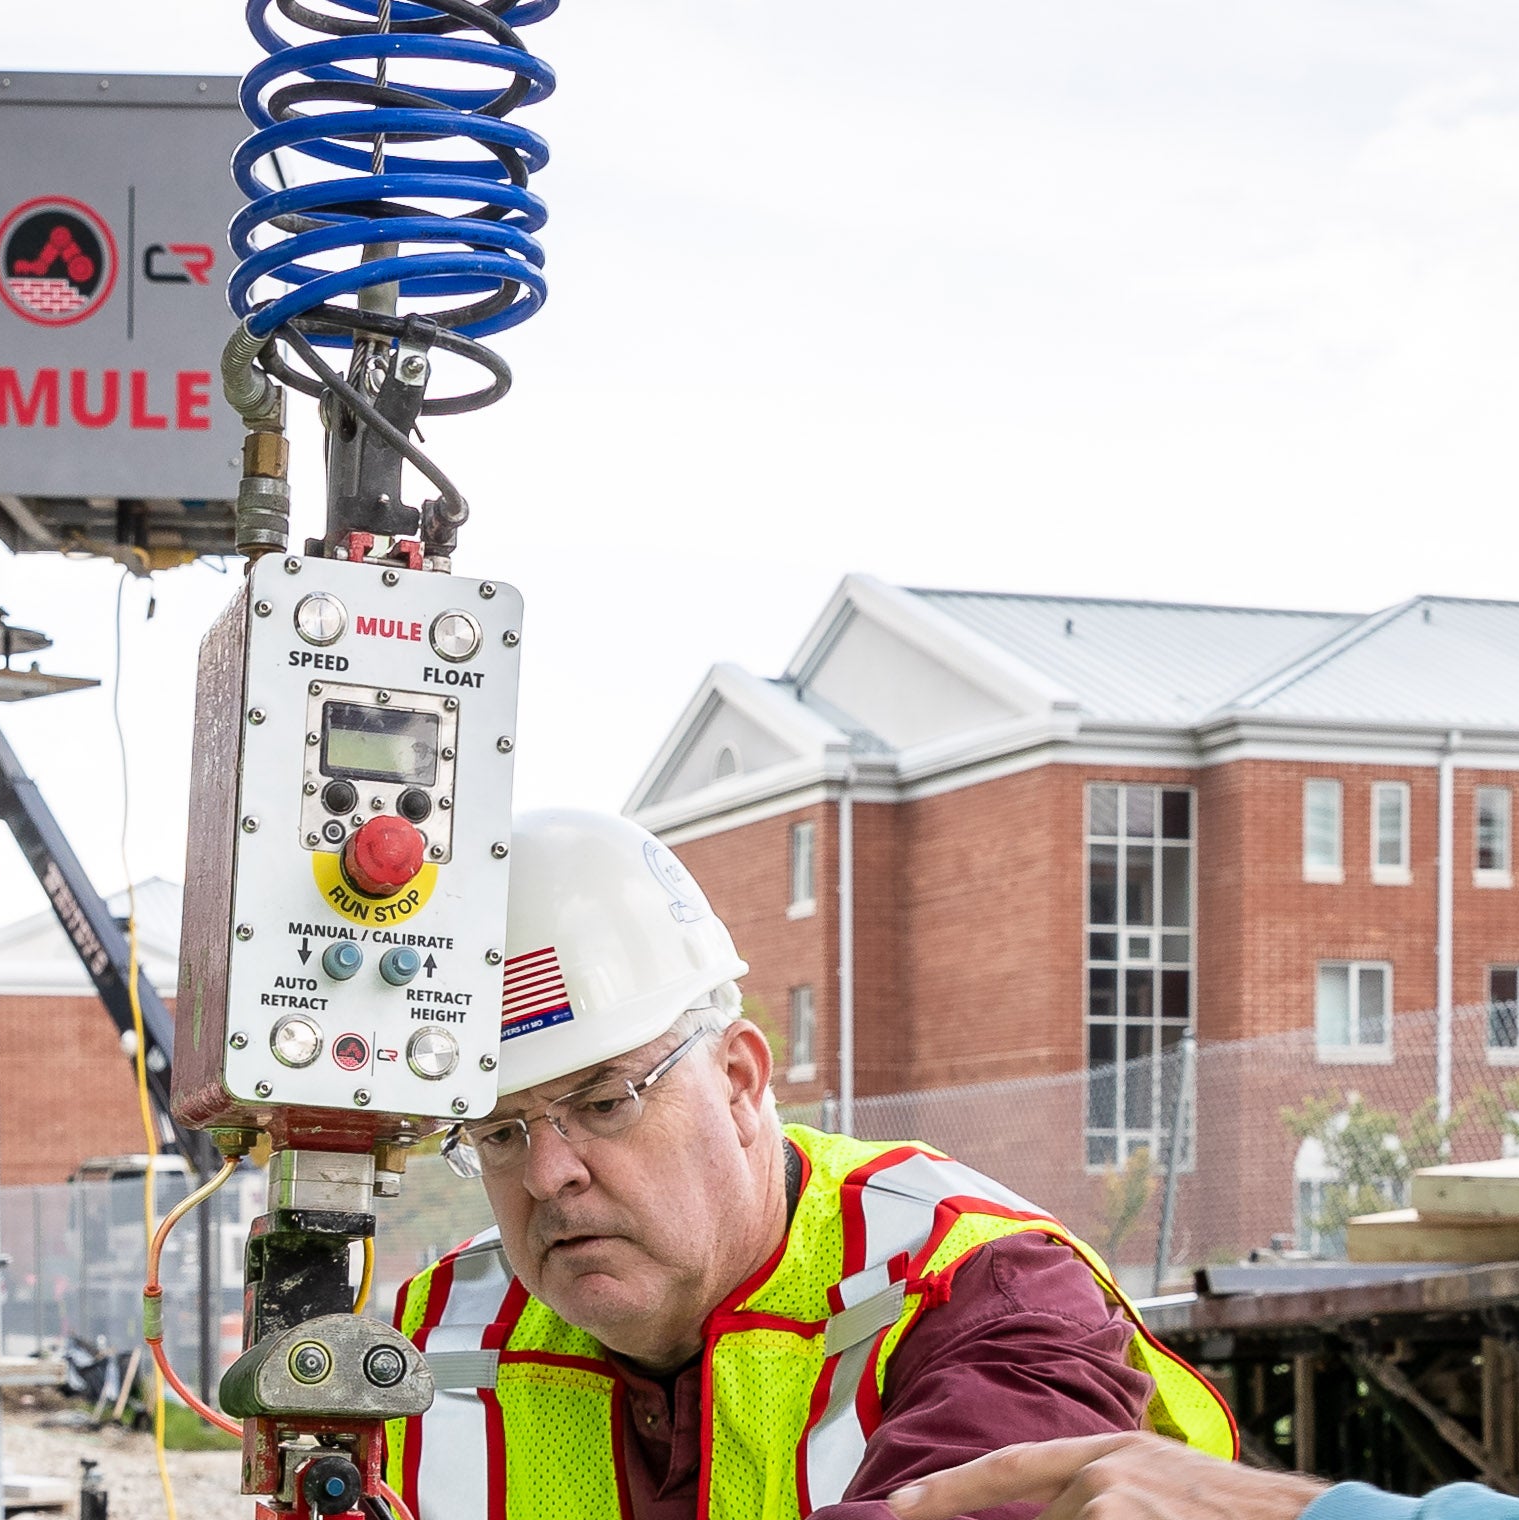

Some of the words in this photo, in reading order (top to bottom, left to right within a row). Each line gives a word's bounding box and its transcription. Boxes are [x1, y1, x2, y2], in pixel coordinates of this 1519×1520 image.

[144, 243, 215, 285] CR
[356, 616, 422, 641] MULE
[288, 650, 349, 672] SPEED
[423, 667, 485, 689] FLOAT
[328, 885, 369, 920] RUN
[374, 889, 420, 922] STOP
[288, 922, 358, 941] MANUAL
[372, 931, 454, 950] CALIBRATE
[274, 975, 318, 991] AUTO
[261, 993, 329, 1011] RETRACT
[406, 988, 473, 1006] RETRACT
[411, 1007, 467, 1024] HEIGHT
